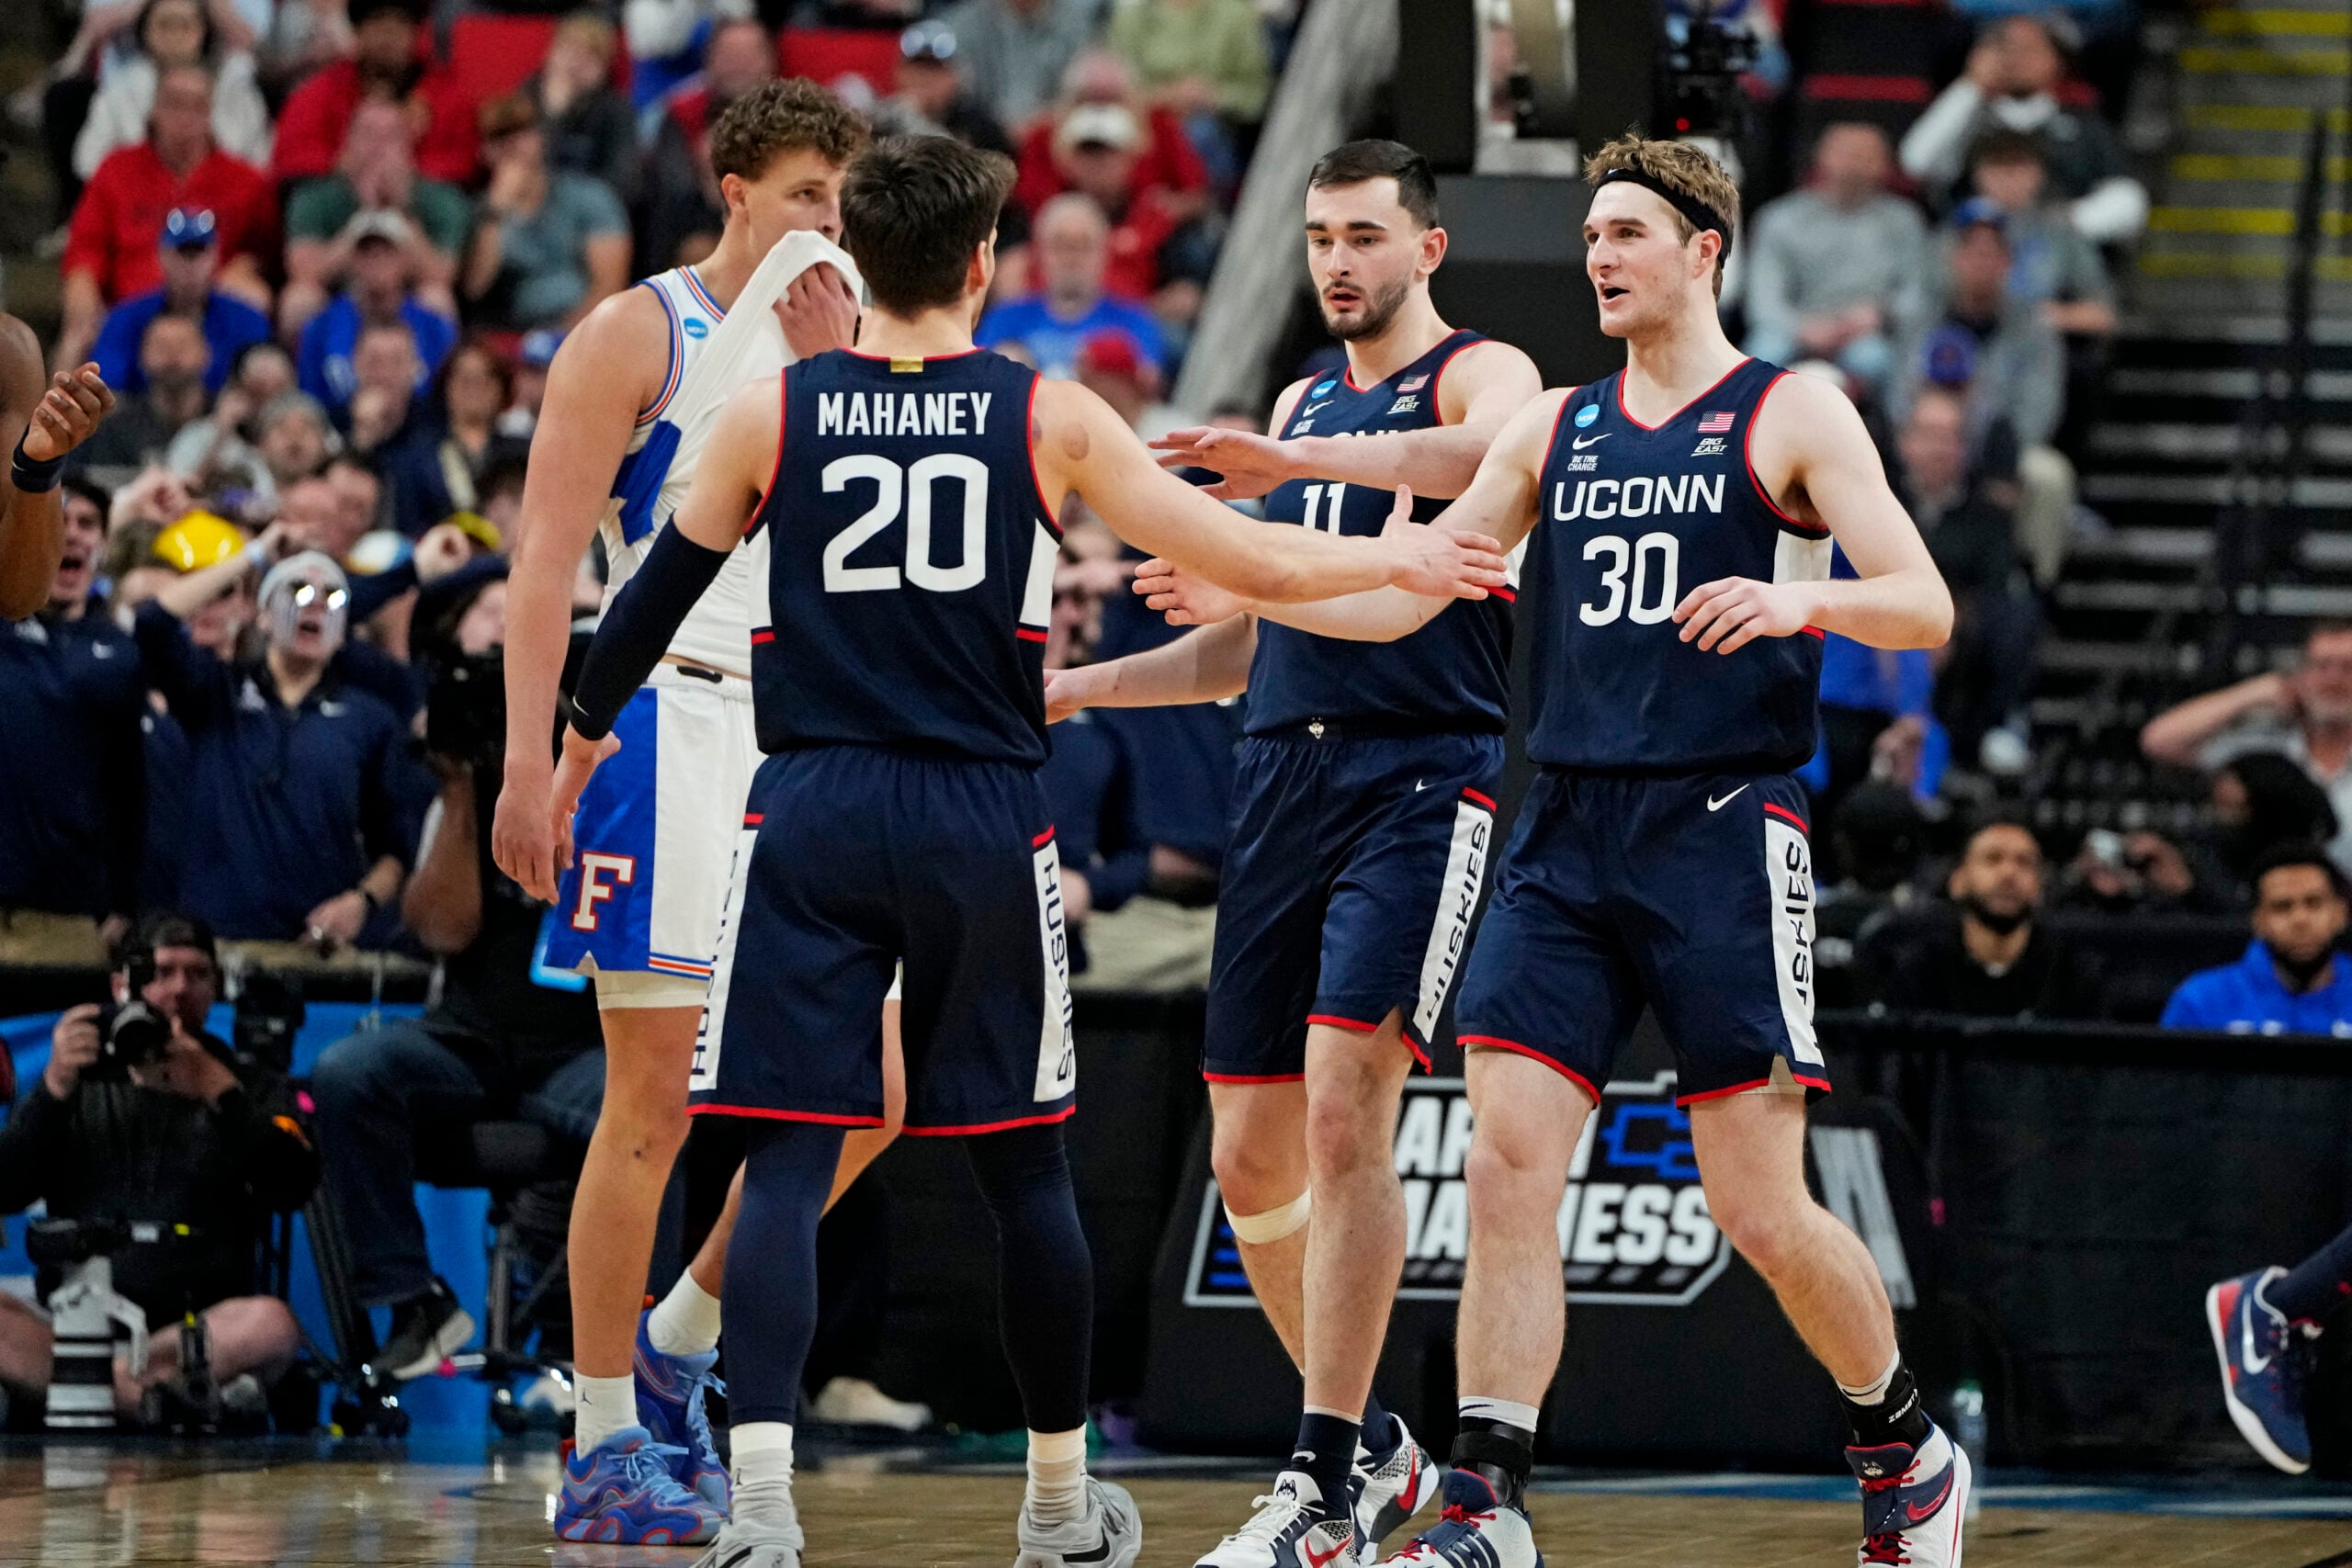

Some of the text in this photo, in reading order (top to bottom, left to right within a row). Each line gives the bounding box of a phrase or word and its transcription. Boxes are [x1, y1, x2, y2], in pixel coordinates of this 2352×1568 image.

[818, 392, 992, 435] MAHANEY
[1572, 455, 1599, 463] BE THE
[1694, 445, 1728, 453] EAST
[1699, 437, 1724, 446] BIG
[1567, 462, 1598, 471] CHANGE
[1303, 482, 1346, 536] 11
[1554, 474, 1725, 521] UCONN
[821, 453, 989, 592] 20
[1579, 532, 1679, 626] 30
[571, 851, 636, 931] F
